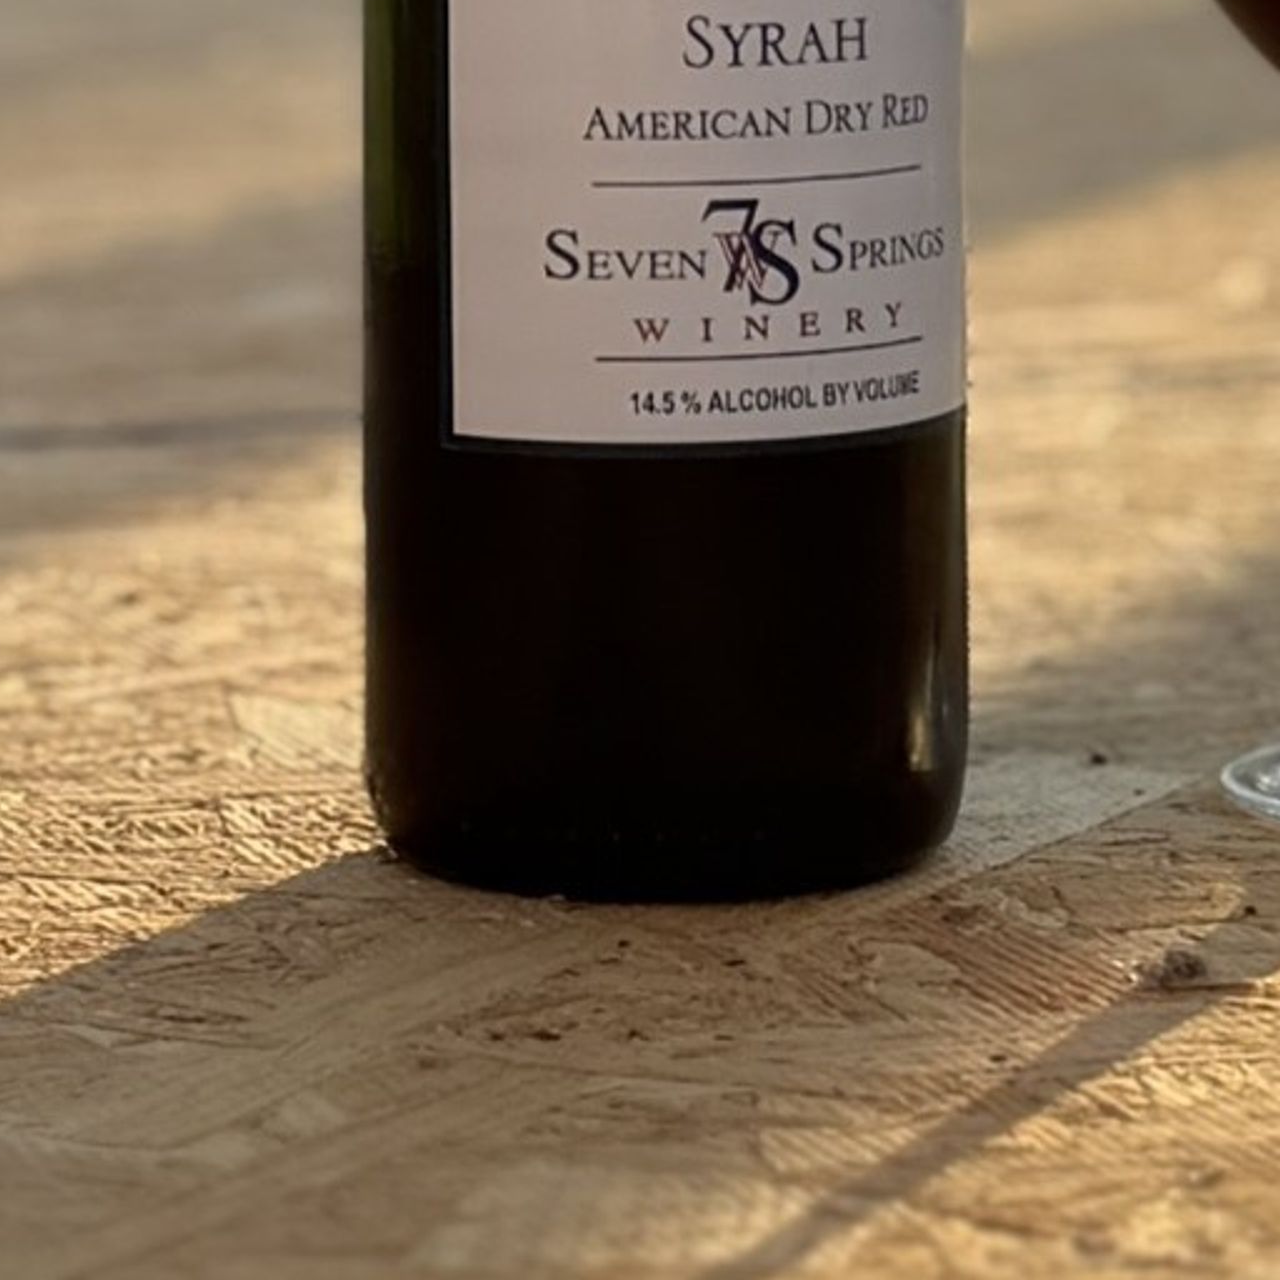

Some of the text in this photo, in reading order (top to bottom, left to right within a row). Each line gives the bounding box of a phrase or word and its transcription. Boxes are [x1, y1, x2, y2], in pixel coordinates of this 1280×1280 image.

[682, 13, 870, 70] SYRAH
[582, 92, 930, 141] AMERICAN DRY RED
[543, 228, 708, 281] SEVEN
[810, 222, 946, 274] SPRINGS
[633, 301, 903, 344] WINERY
[707, 383, 819, 413] ALCOHOL
[823, 380, 851, 407] BY
[854, 369, 921, 403] VOLUME
